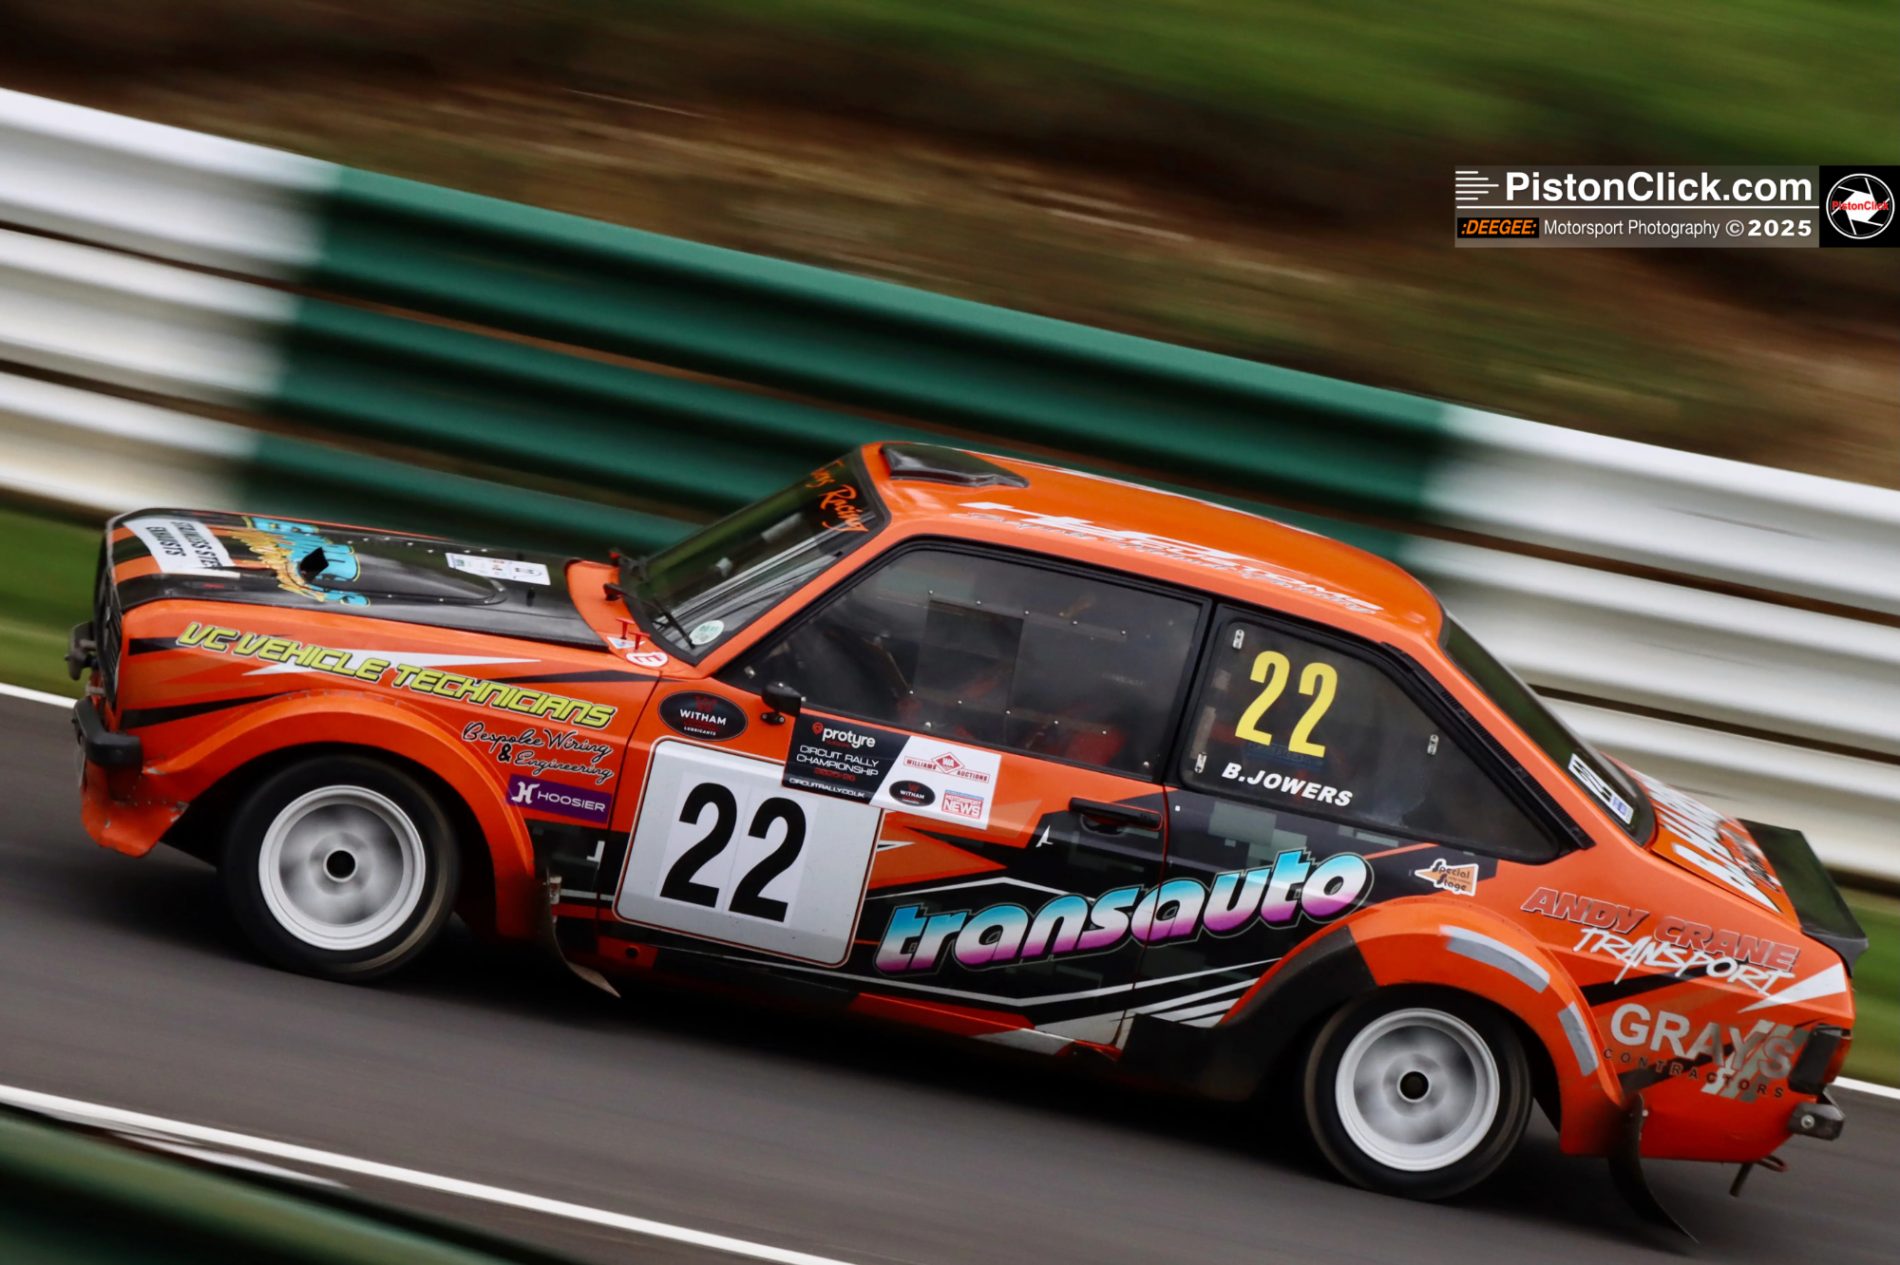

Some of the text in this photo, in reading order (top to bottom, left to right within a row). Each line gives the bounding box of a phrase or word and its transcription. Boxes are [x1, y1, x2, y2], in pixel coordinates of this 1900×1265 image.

[818, 484, 869, 532] Racing
[176, 621, 618, 730] VC VEHICLE TECHNICIANS
[680, 708, 727, 726] WITHAM
[1234, 650, 1338, 759] 22
[462, 721, 613, 764] Bespoke Wiring
[799, 744, 842, 759] CIRCUIT
[844, 754, 879, 768] RALLY
[821, 727, 876, 749] protyre
[497, 743, 615, 785] & Engineering
[796, 753, 879, 776] CHAMPIONSHIP
[906, 758, 937, 770] WILLIAMS
[956, 770, 988, 782] AUCTIONS
[1221, 762, 1354, 807] B.JOWERS
[537, 790, 606, 812] HOOSIER
[900, 789, 925, 799] WITHAM
[942, 798, 981, 817] NEWS
[659, 781, 807, 923] 22
[876, 847, 1371, 975] transauto
[1521, 886, 1800, 972] ANDY CRANE
[1573, 927, 1796, 997] TRANSPORT
[1610, 1002, 1796, 1080] GRAYS
[1603, 1047, 1784, 1099] CONTRACTORS
